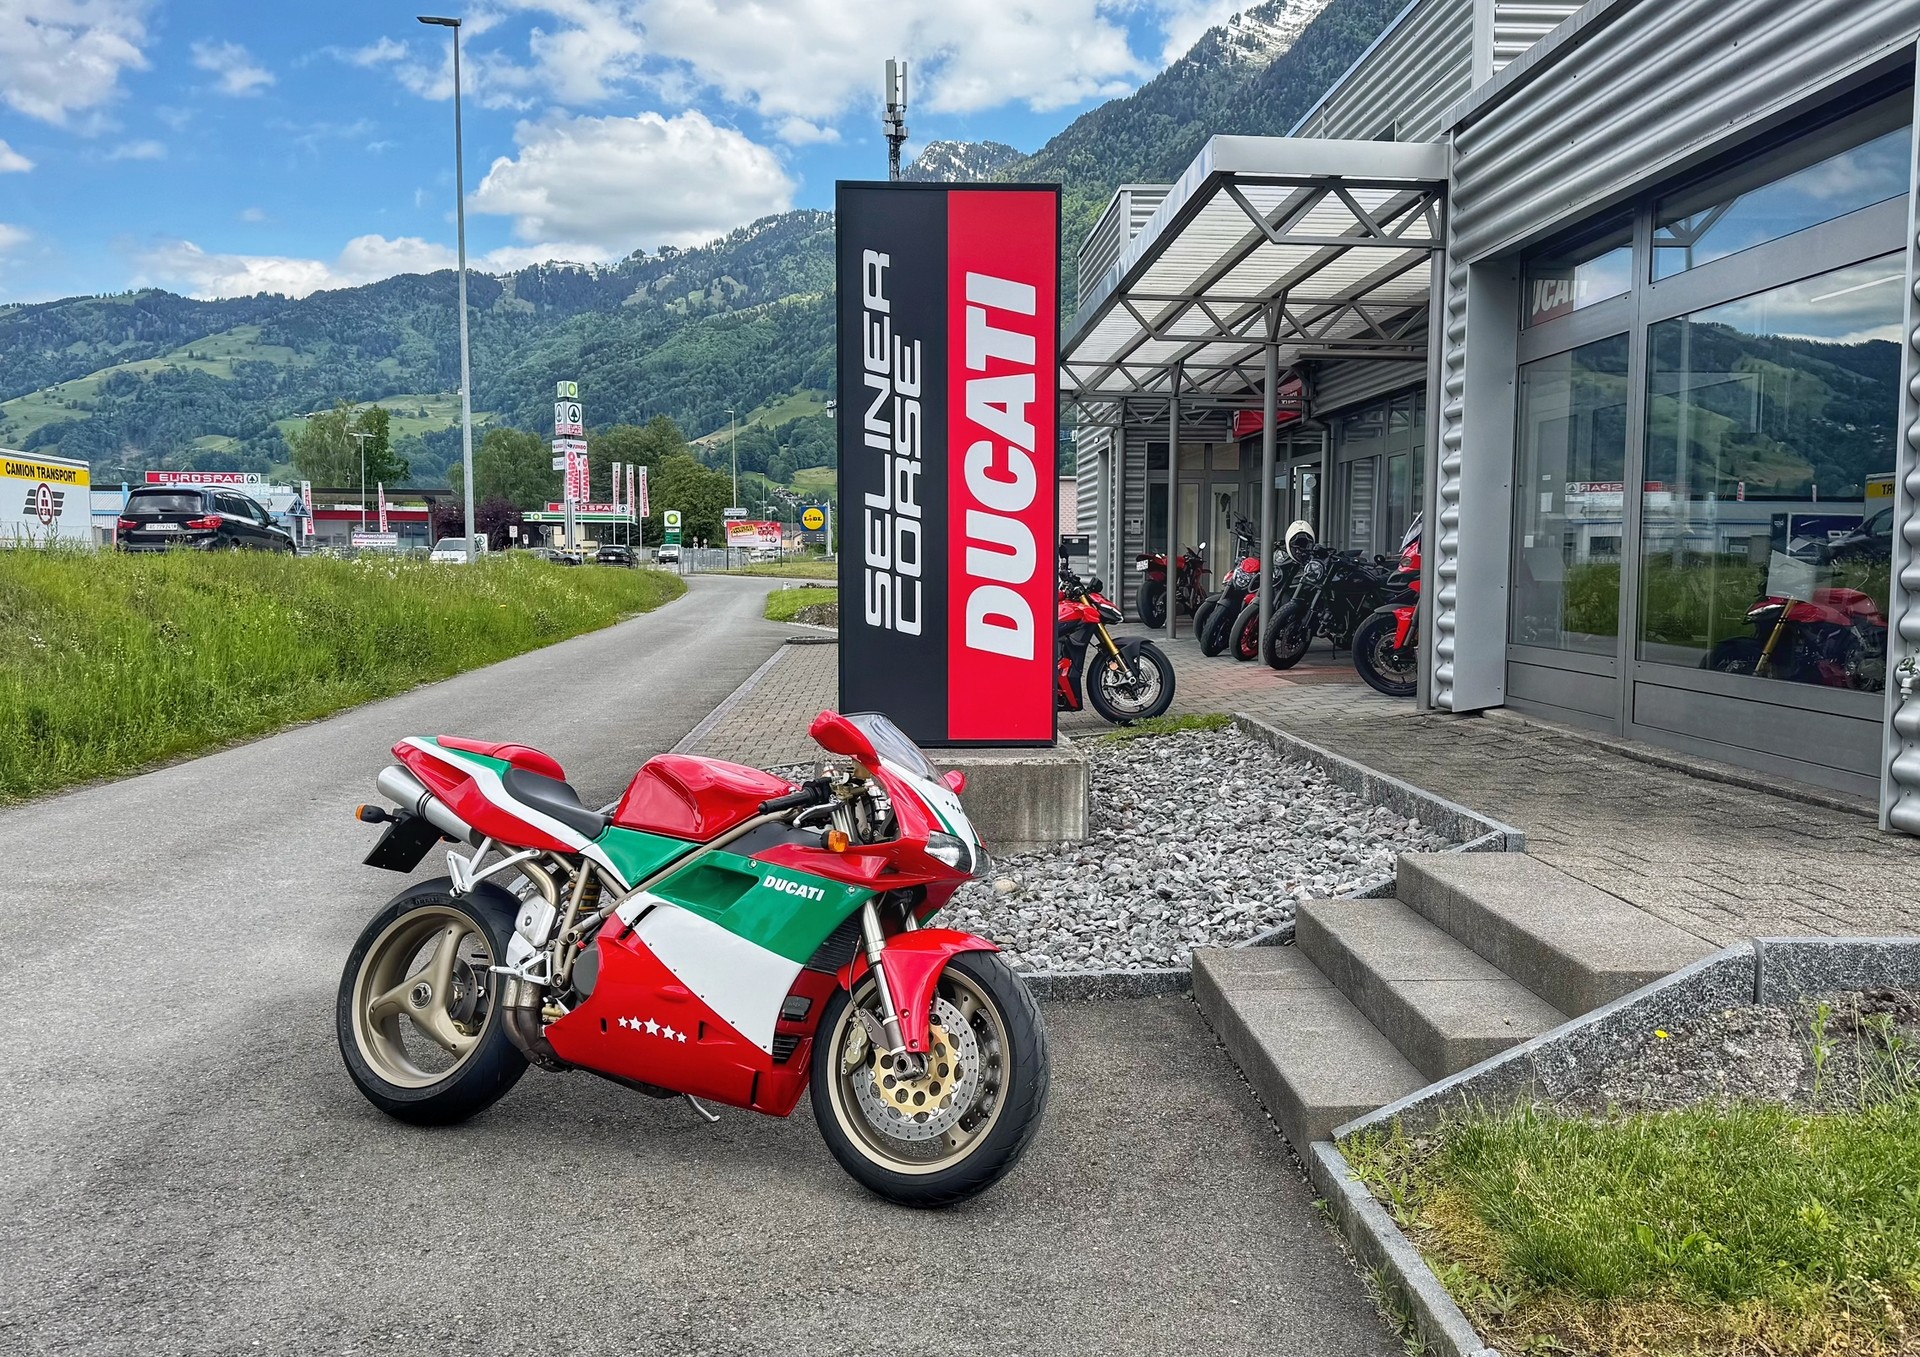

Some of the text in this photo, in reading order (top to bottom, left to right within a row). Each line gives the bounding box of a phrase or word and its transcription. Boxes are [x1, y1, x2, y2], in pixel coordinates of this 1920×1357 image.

[5, 461, 76, 482] CAMION TRANSPORT
[159, 473, 243, 483] EUROSPAR
[862, 249, 892, 631] SELINER
[894, 334, 922, 637] CORSE
[964, 271, 1037, 661] DUCATI
[762, 875, 825, 901] DUCATI
